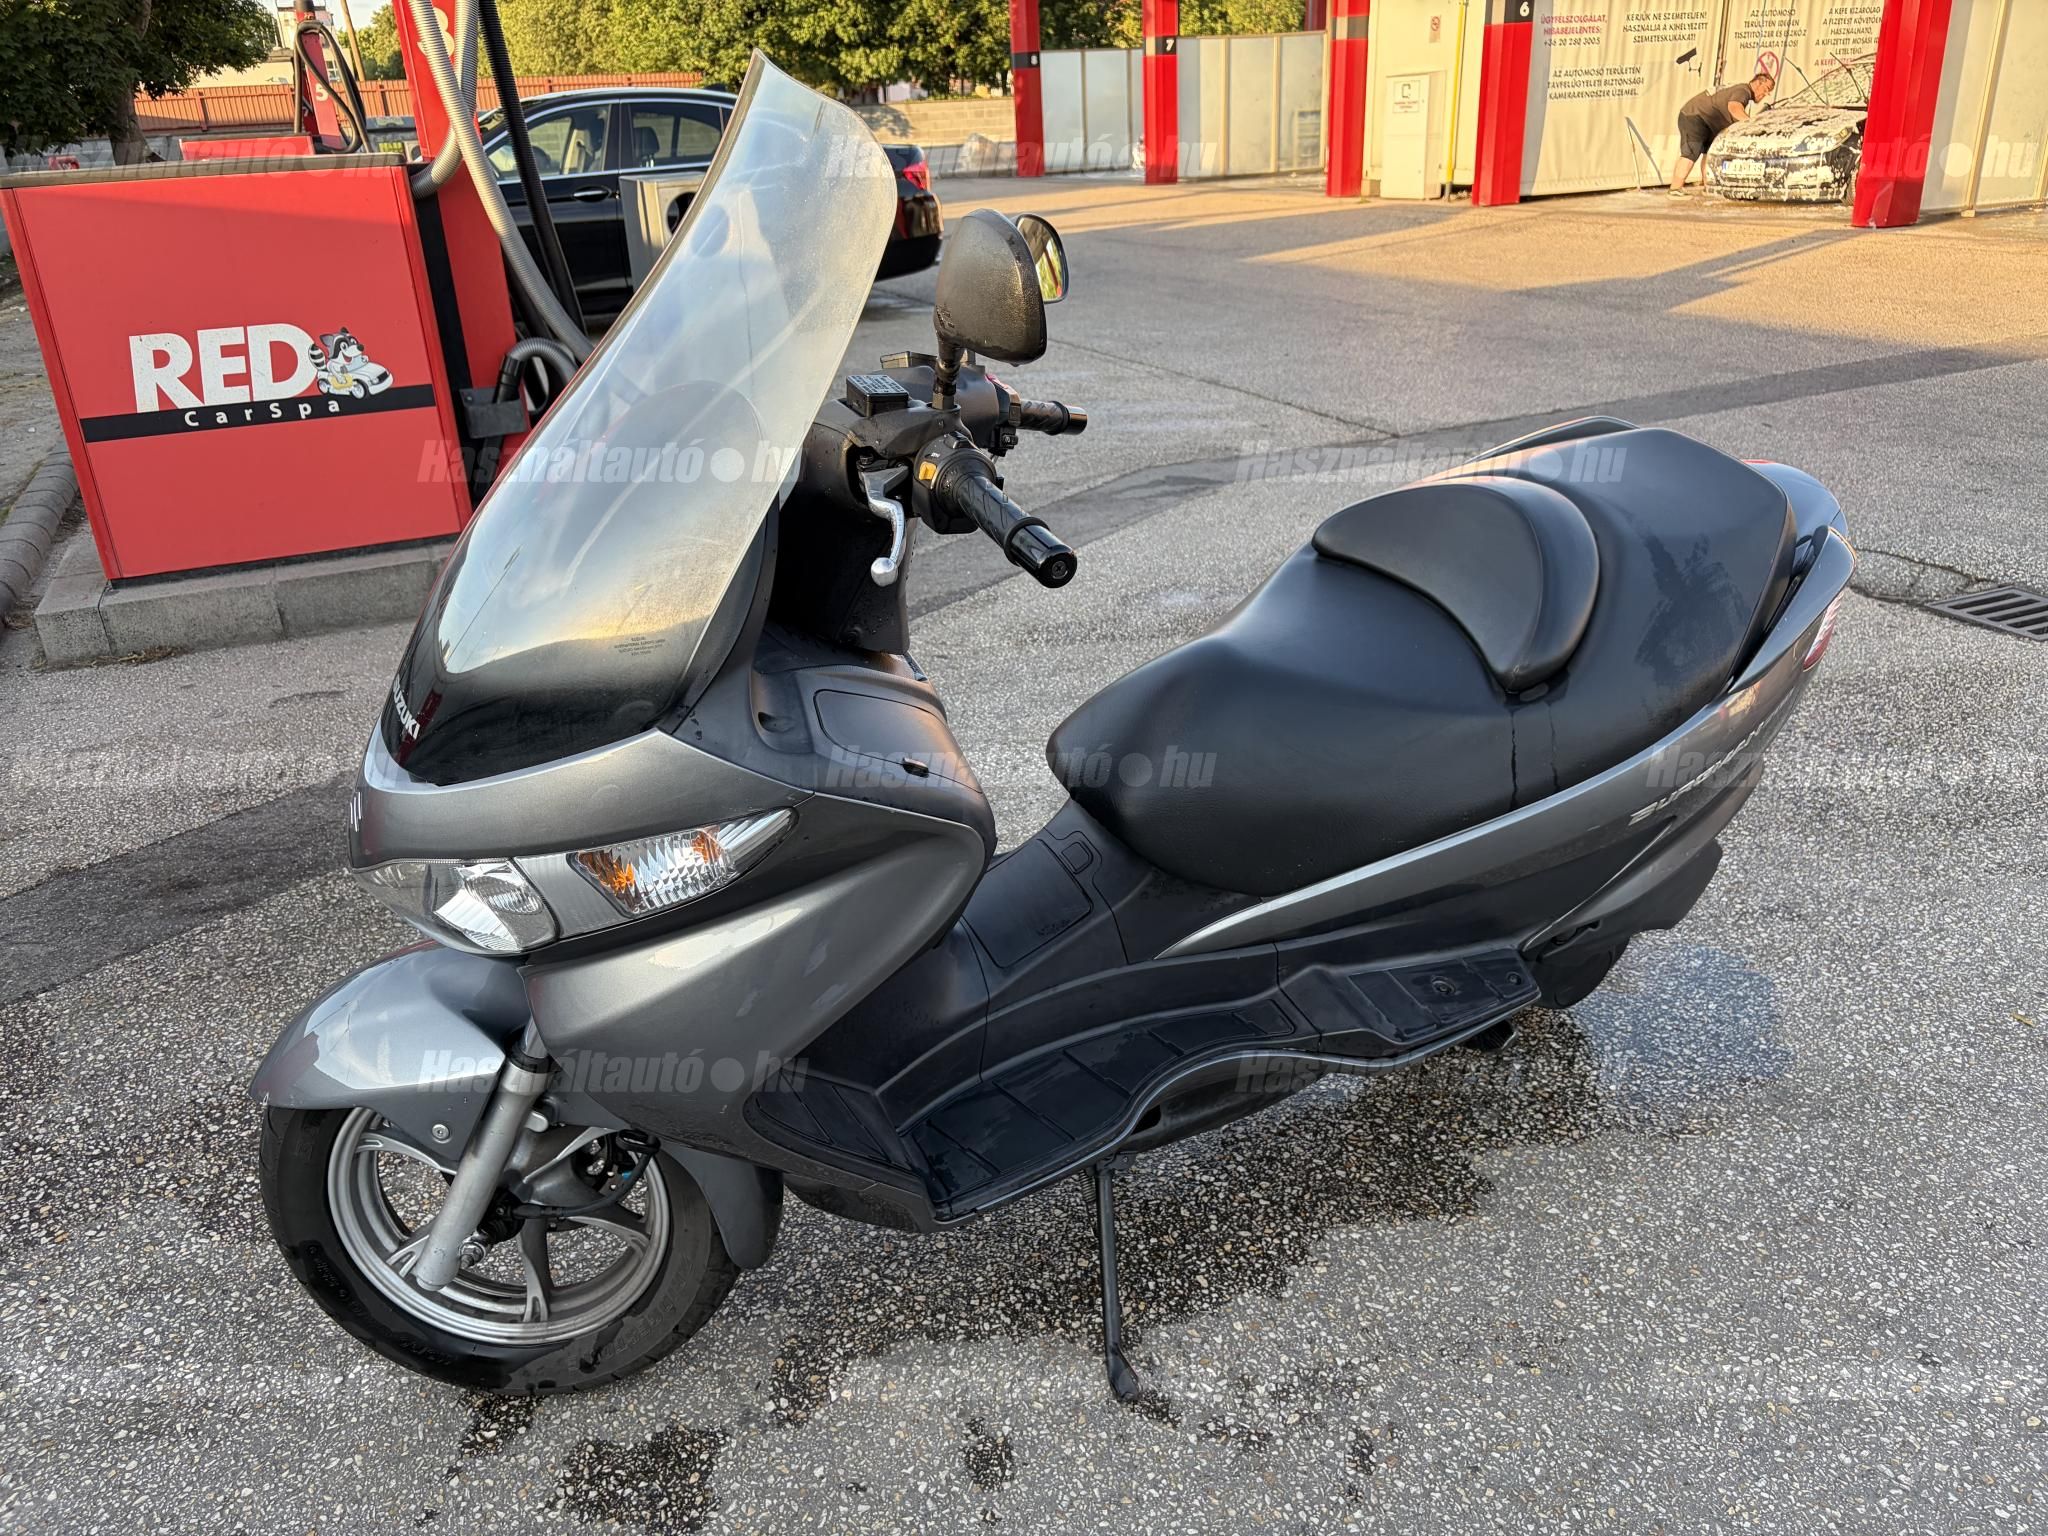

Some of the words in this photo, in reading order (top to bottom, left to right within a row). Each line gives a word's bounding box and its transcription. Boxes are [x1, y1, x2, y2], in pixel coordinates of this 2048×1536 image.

[1519, 1, 1530, 17] 6
[1750, 9, 1760, 17] AZ
[1652, 13, 1662, 21] NE
[1166, 39, 1174, 51] 7
[315, 82, 329, 102] 5
[128, 322, 319, 414] RED
